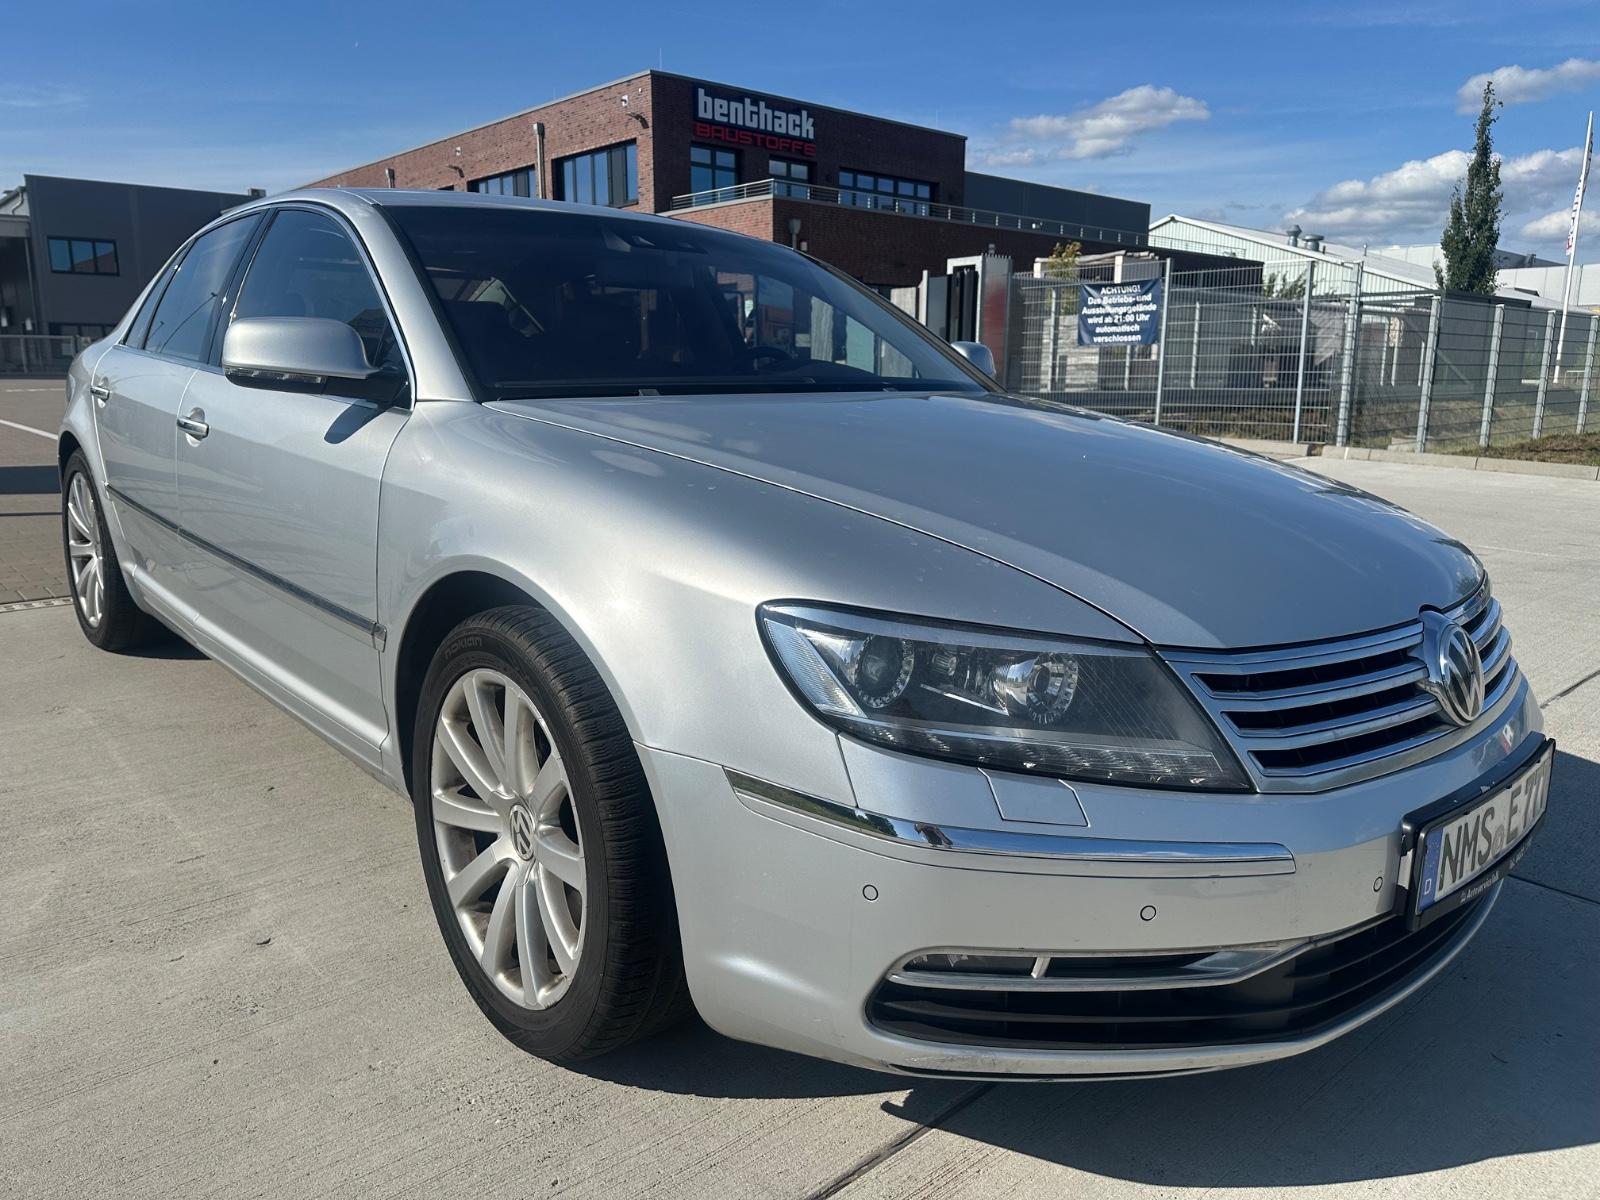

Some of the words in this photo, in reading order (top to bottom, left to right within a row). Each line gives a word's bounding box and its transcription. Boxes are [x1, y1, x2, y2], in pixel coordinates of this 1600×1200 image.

[698, 87, 815, 139] benthack
[695, 123, 817, 157] BAUSTOFFE
[1100, 285, 1141, 295] ACHTUNG!
[1102, 295, 1136, 305] Betriebs-
[1136, 293, 1152, 302] und
[1087, 316, 1103, 324] wird
[1104, 316, 1113, 324] ab
[1135, 313, 1150, 322] Uhr
[1095, 324, 1140, 333] automatisch
[1093, 334, 1142, 343] verschlossen
[1437, 806, 1496, 893] NMS
